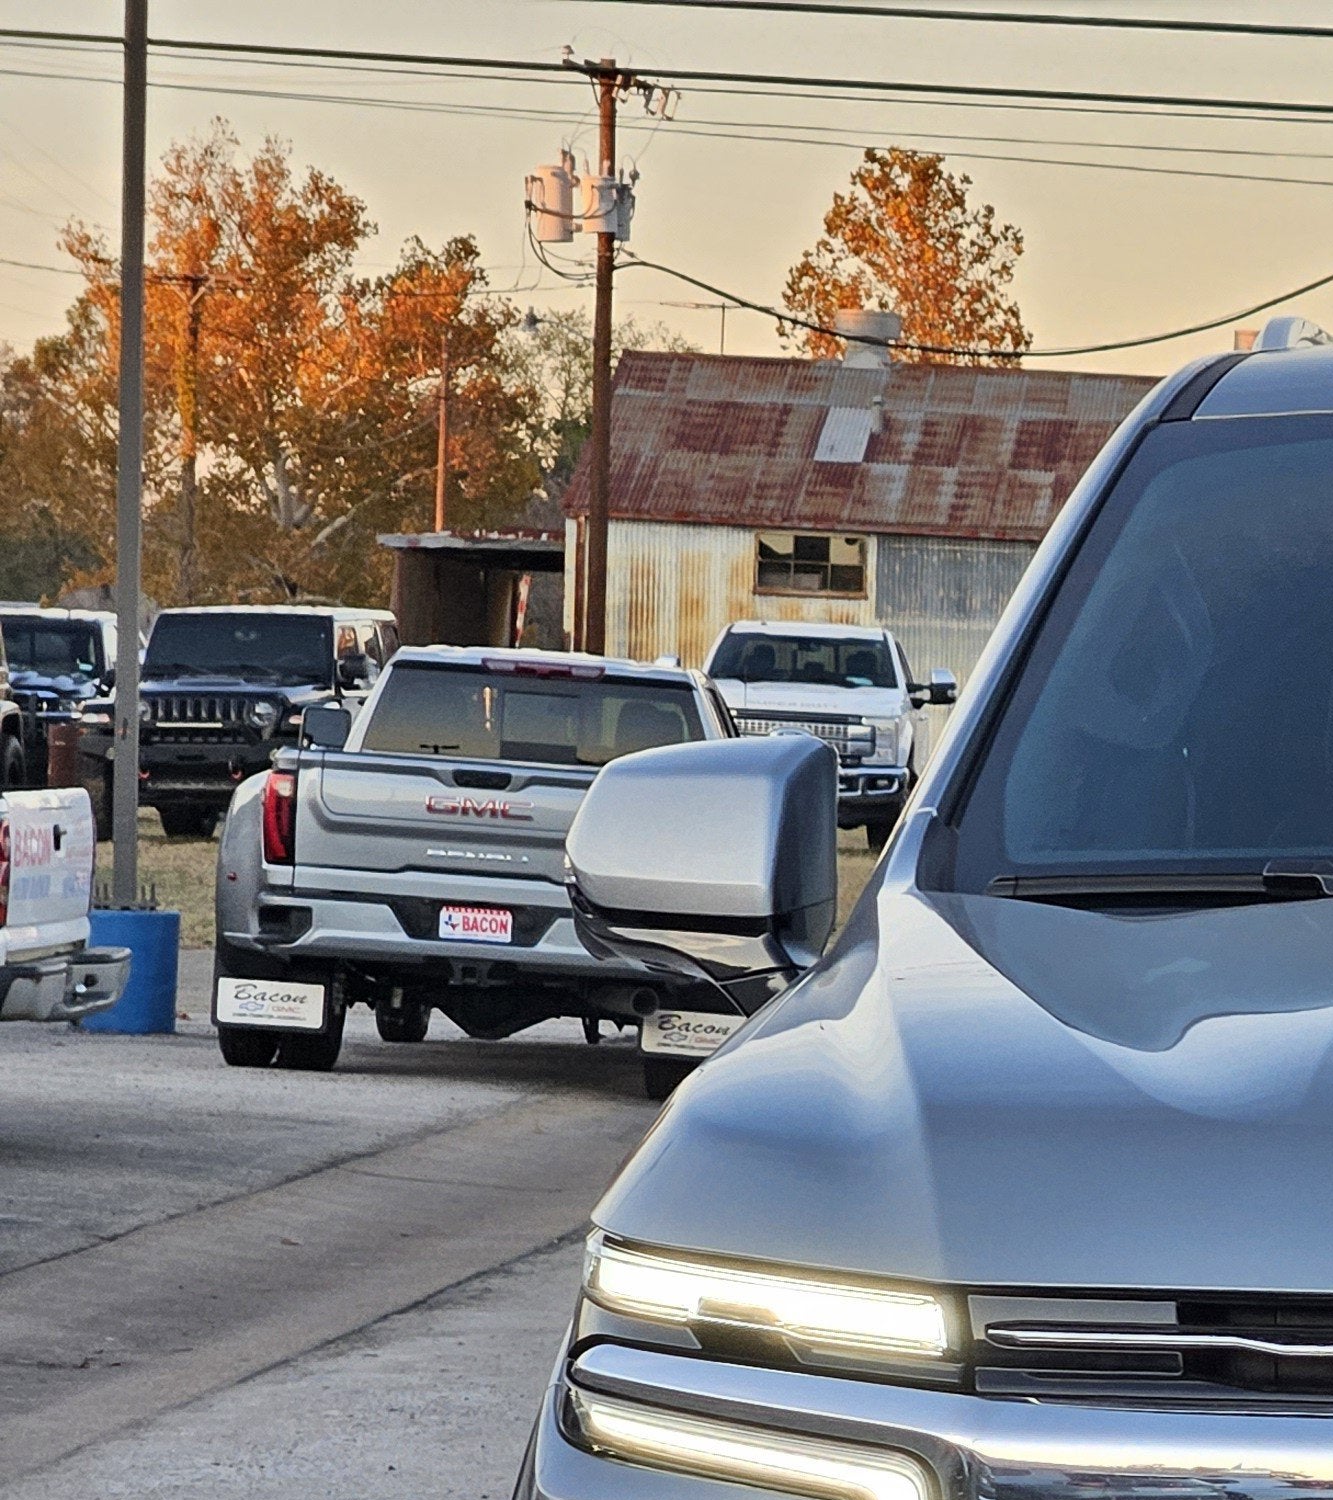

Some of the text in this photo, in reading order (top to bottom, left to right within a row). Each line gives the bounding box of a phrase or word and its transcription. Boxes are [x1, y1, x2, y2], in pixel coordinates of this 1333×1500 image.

[425, 796, 534, 821] GMC
[462, 915, 509, 934] BACON
[234, 983, 308, 1004] Bacon
[658, 1014, 730, 1036] Bacon
